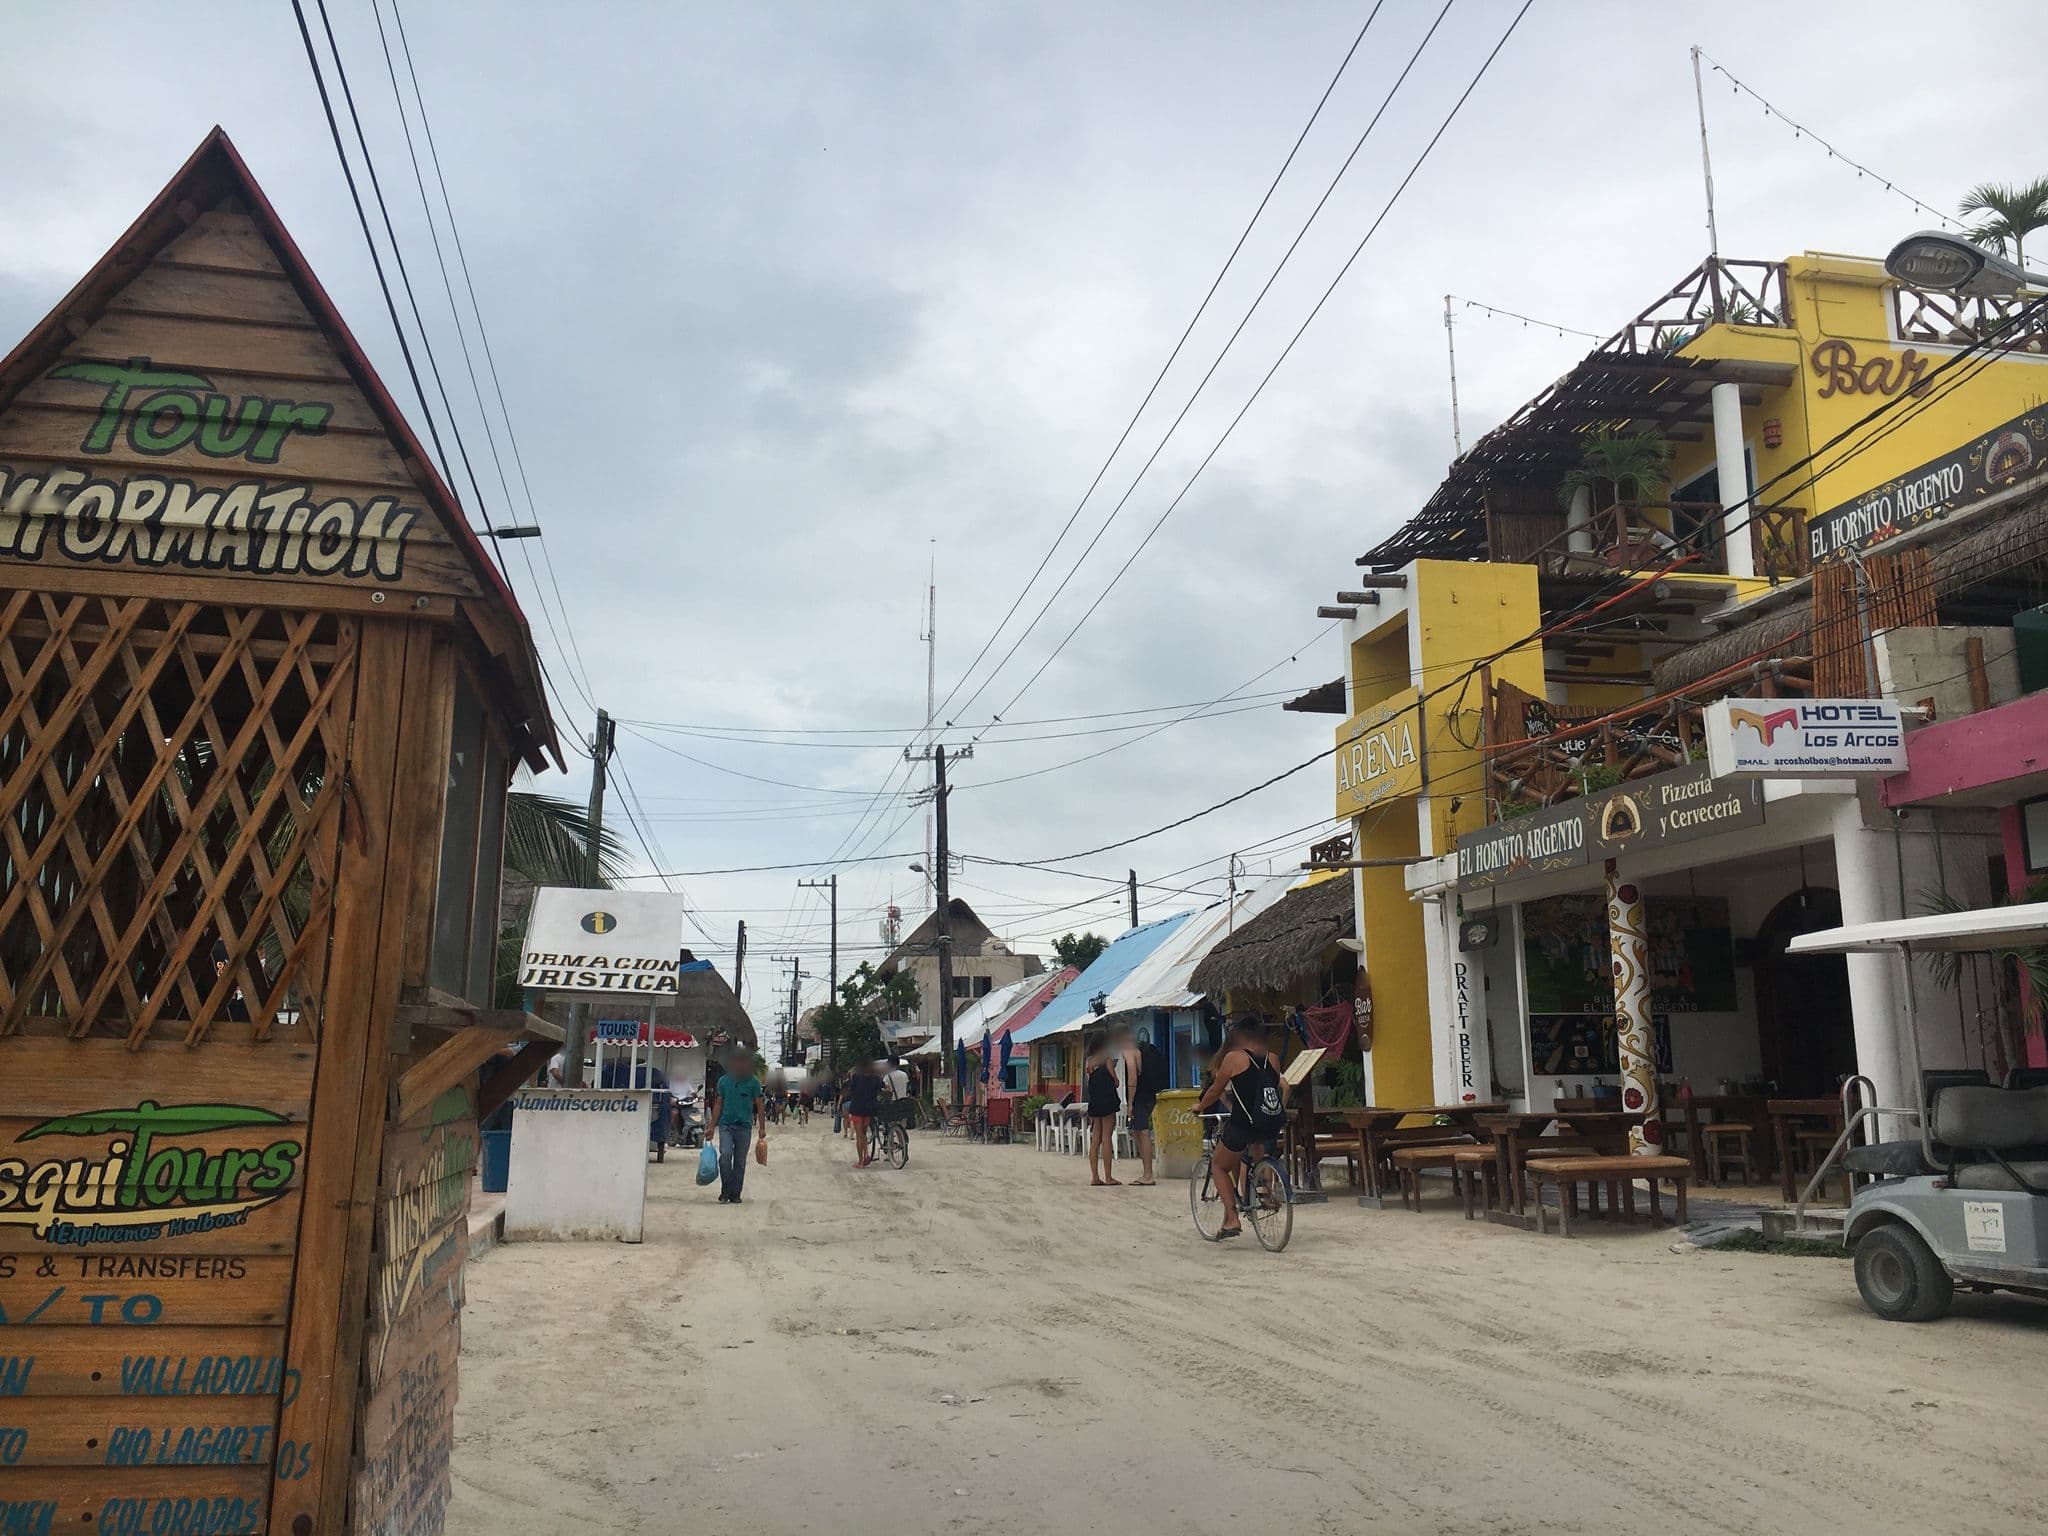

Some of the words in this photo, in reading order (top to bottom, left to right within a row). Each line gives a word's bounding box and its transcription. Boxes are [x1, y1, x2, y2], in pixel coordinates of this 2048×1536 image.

[1812, 340, 1935, 398] Bar
[46, 357, 334, 463] Tour
[1811, 526, 1828, 559] EL
[1896, 463, 1964, 521] ARGENTO
[1802, 706, 1896, 721] HOTEL
[1337, 721, 1417, 794] ARENA
[1805, 732, 1838, 747] Los
[1844, 732, 1899, 747] Arcos
[1774, 756, 1893, 767] arcosholbox@hotmail.com
[1661, 773, 1713, 805] Pizzería
[1660, 815, 1668, 837] y
[1670, 793, 1742, 829] Cervecería
[1460, 848, 1473, 876] EL
[1526, 817, 1583, 859] ARGENTO
[1354, 997, 1372, 1015] Bar
[1454, 963, 1470, 1029] DRAFT
[599, 1022, 638, 1037] TOURS
[1459, 1033, 1473, 1087] BEER
[36, 1255, 59, 1278] &
[76, 1255, 247, 1280] TRANSFERS
[80, 1294, 164, 1325] TO
